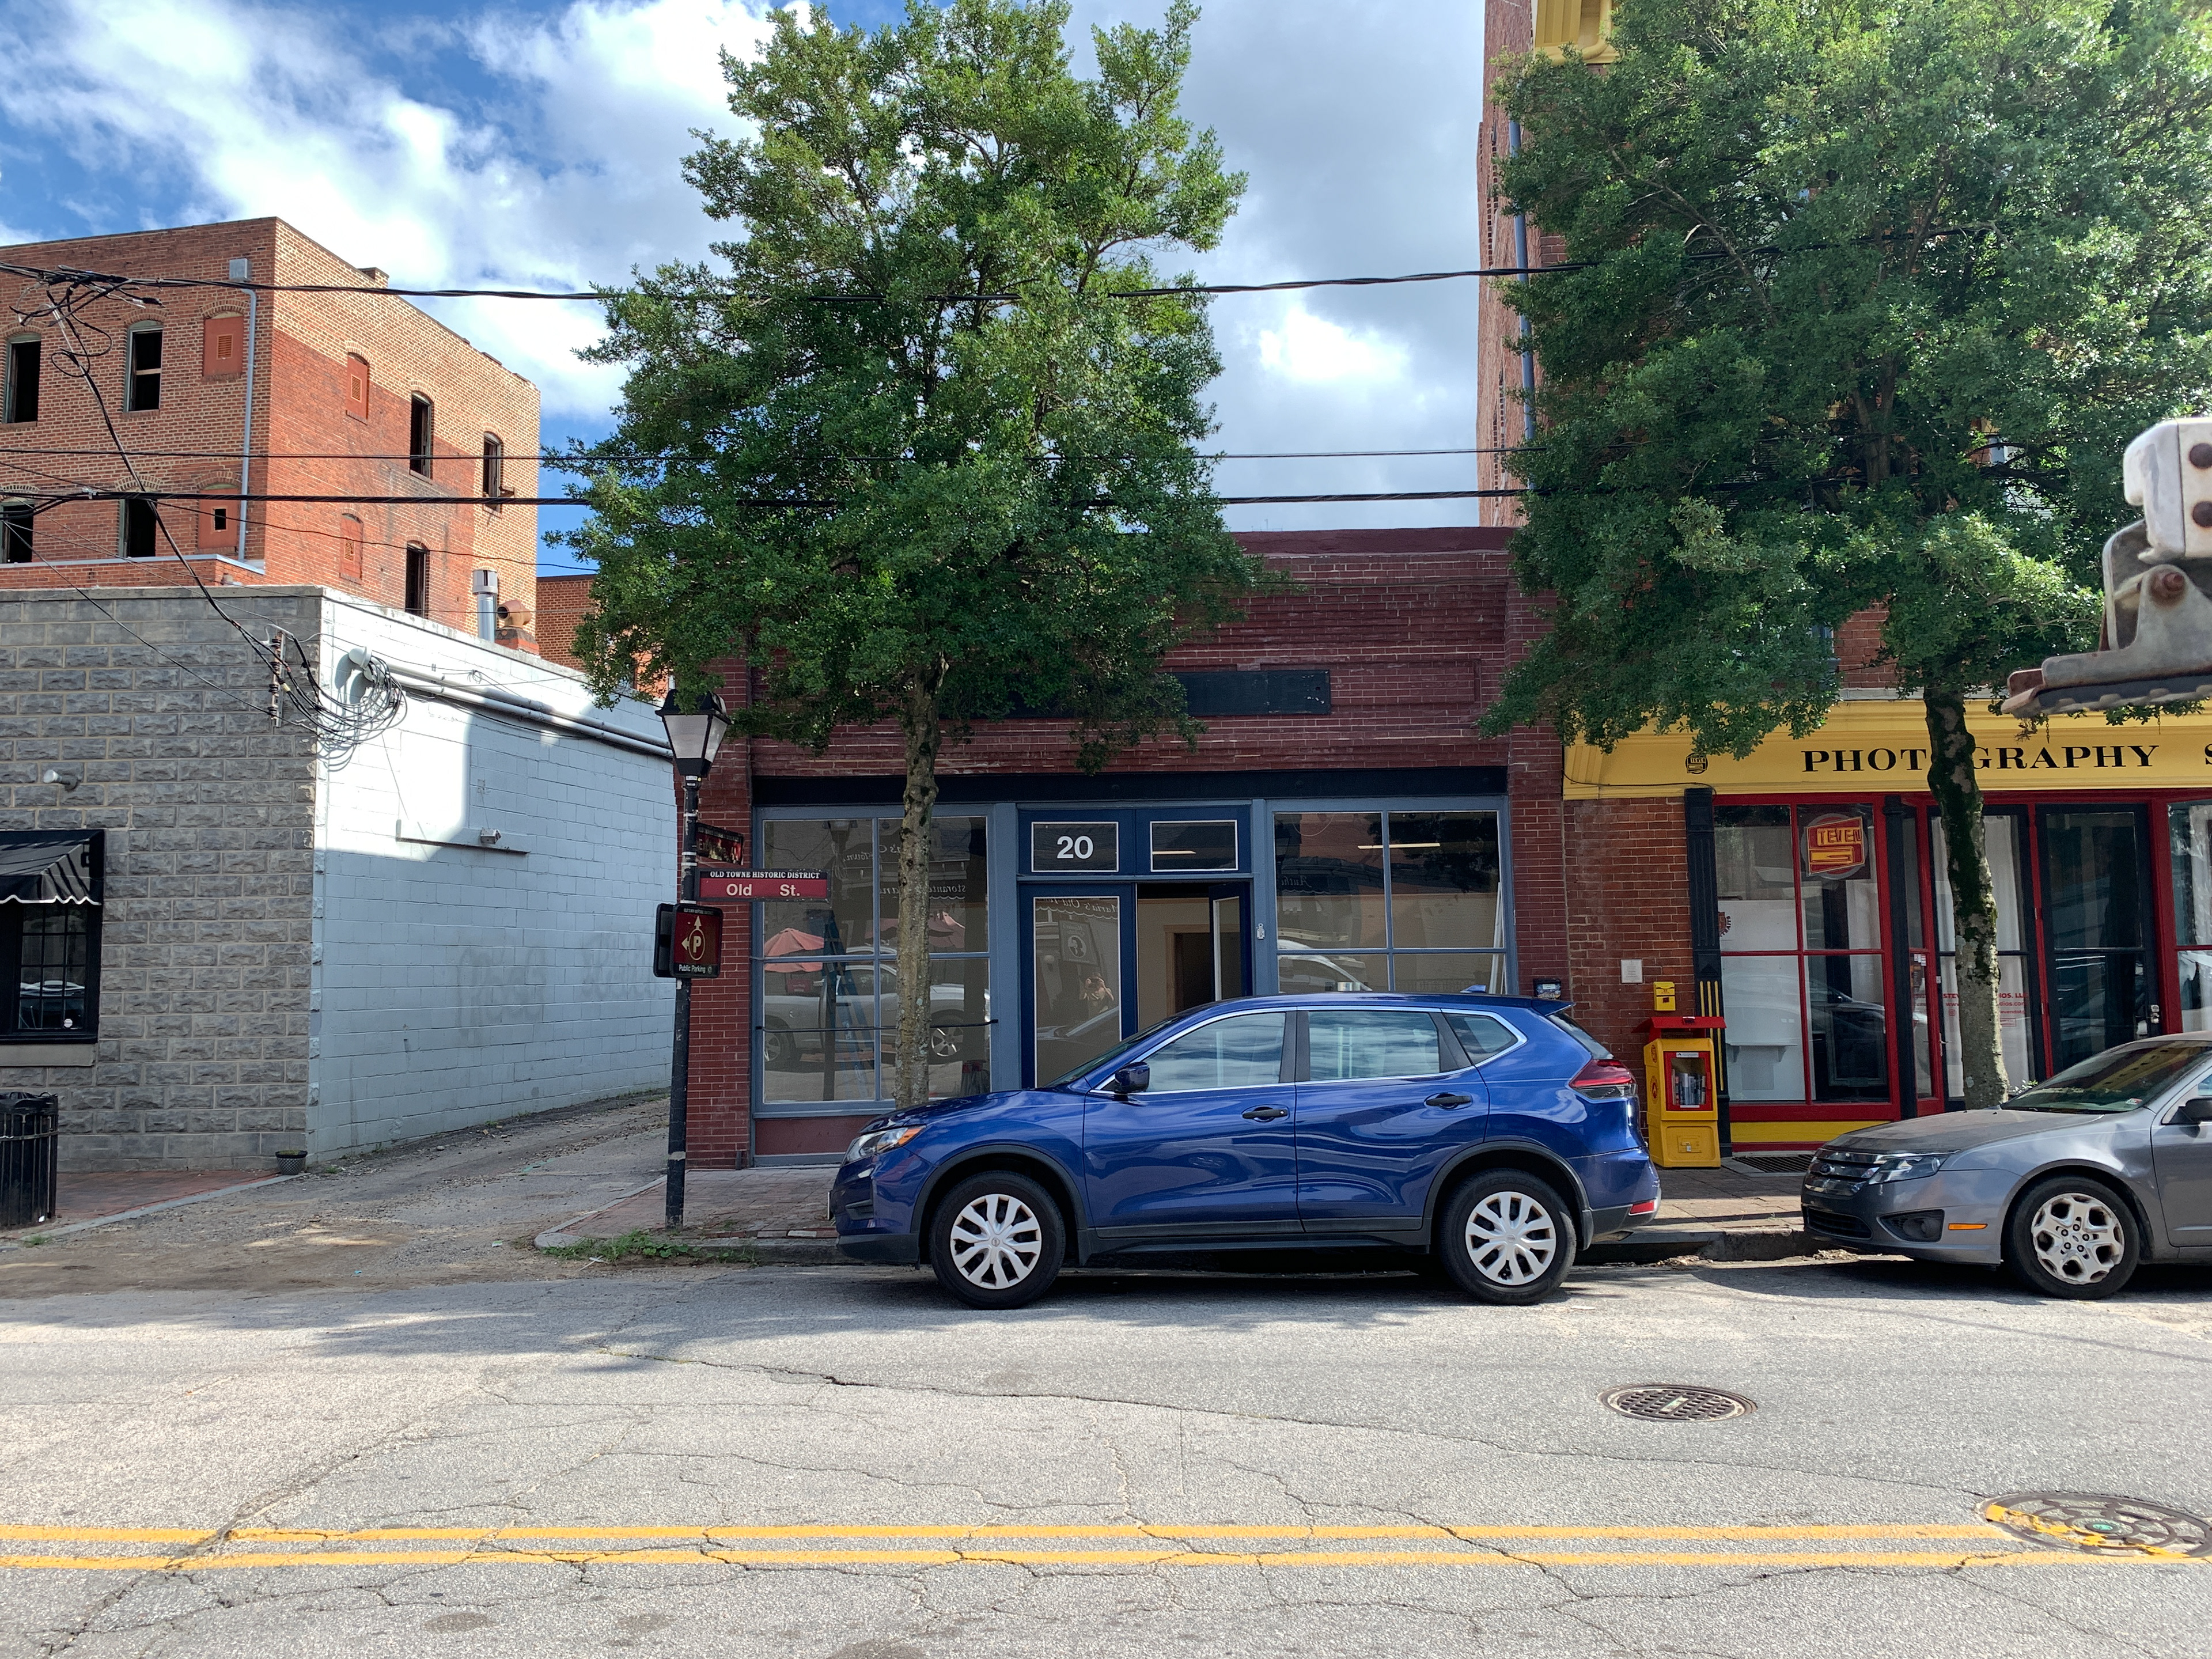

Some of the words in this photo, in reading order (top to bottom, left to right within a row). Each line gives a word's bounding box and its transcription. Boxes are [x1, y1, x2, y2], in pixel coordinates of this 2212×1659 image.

[1801, 745, 2159, 772] PHOTGRAPHY
[1056, 835, 1093, 859] 20
[726, 883, 752, 896] Old
[779, 884, 801, 896] St.
[693, 935, 702, 953] P
[679, 964, 691, 972] Public
[691, 964, 706, 974] Parking
